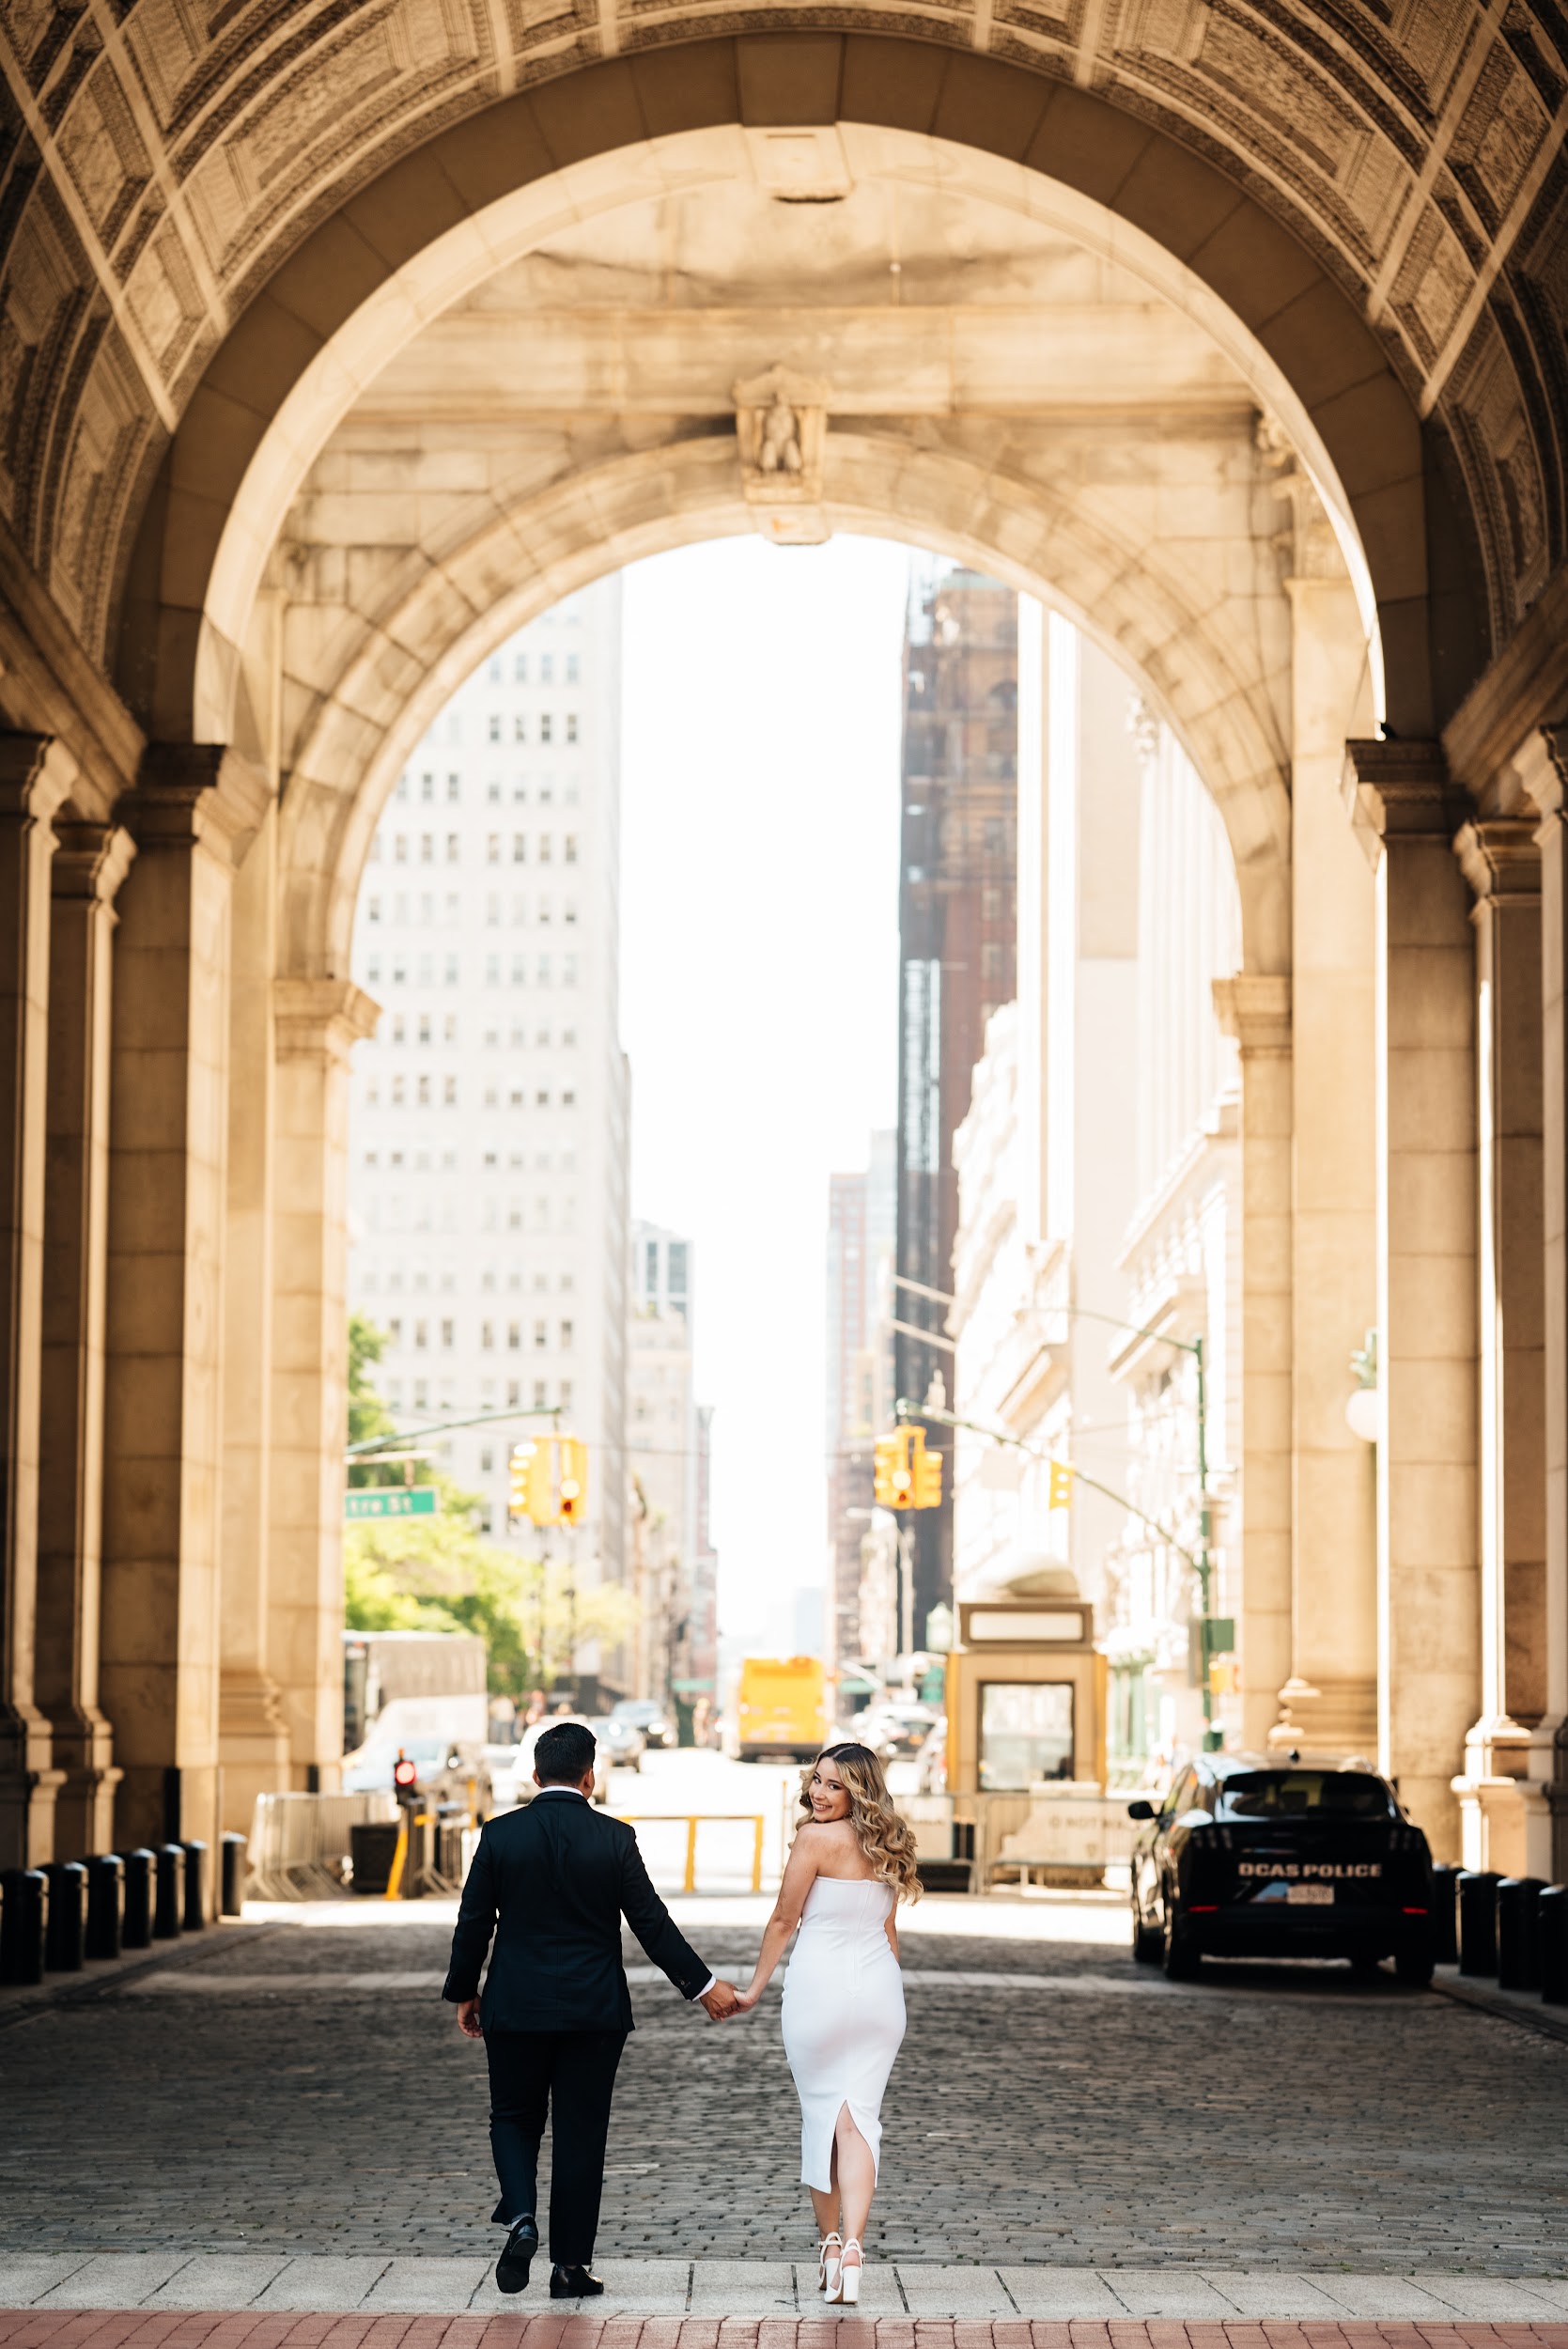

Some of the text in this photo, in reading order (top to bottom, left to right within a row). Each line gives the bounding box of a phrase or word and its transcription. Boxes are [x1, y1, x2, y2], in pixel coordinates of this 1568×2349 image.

[387, 1494, 412, 1513] St
[1238, 1862, 1382, 1878] DCAS POLICE
